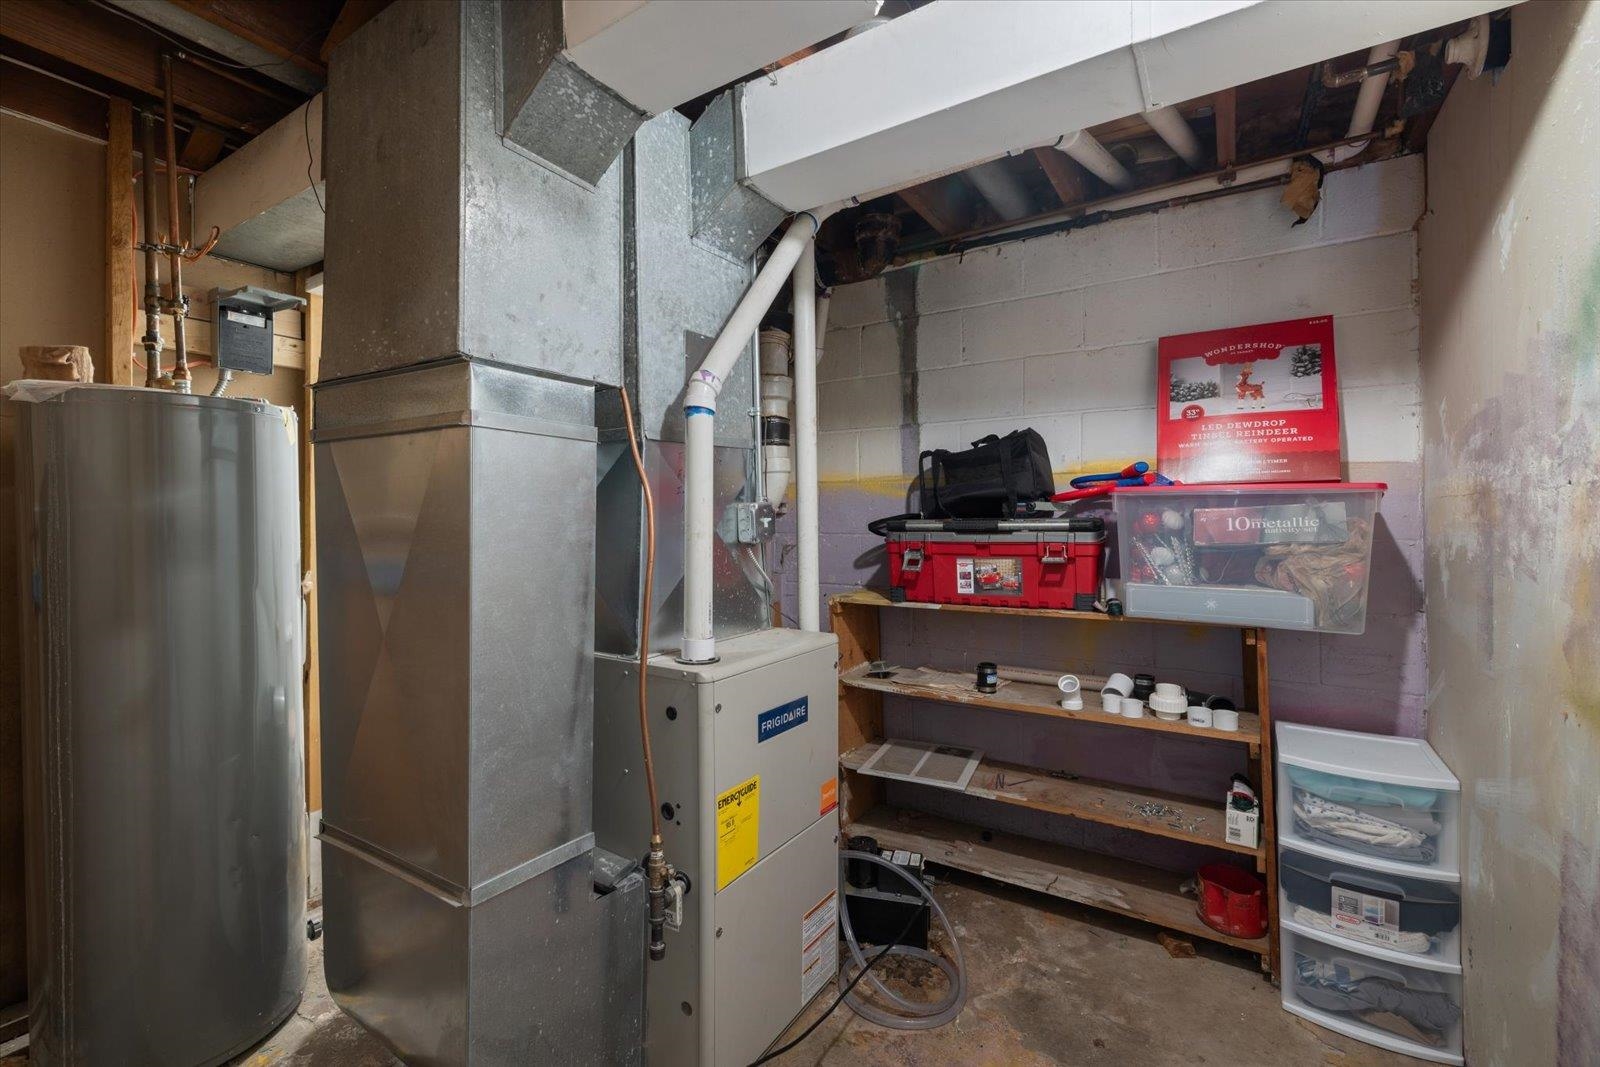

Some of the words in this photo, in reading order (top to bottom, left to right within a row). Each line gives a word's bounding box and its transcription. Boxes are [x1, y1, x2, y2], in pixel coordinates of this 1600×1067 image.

[1204, 342, 1281, 358] WONDERSHOP
[1227, 419, 1287, 430] DEWDROP
[1191, 431, 1232, 441] TINSEL
[1236, 427, 1298, 438] REINDEER
[1270, 435, 1314, 443] OPERATED
[1226, 516, 1250, 532] 10
[1251, 516, 1320, 530] metallic
[761, 705, 806, 733] FRIGIDAIRE
